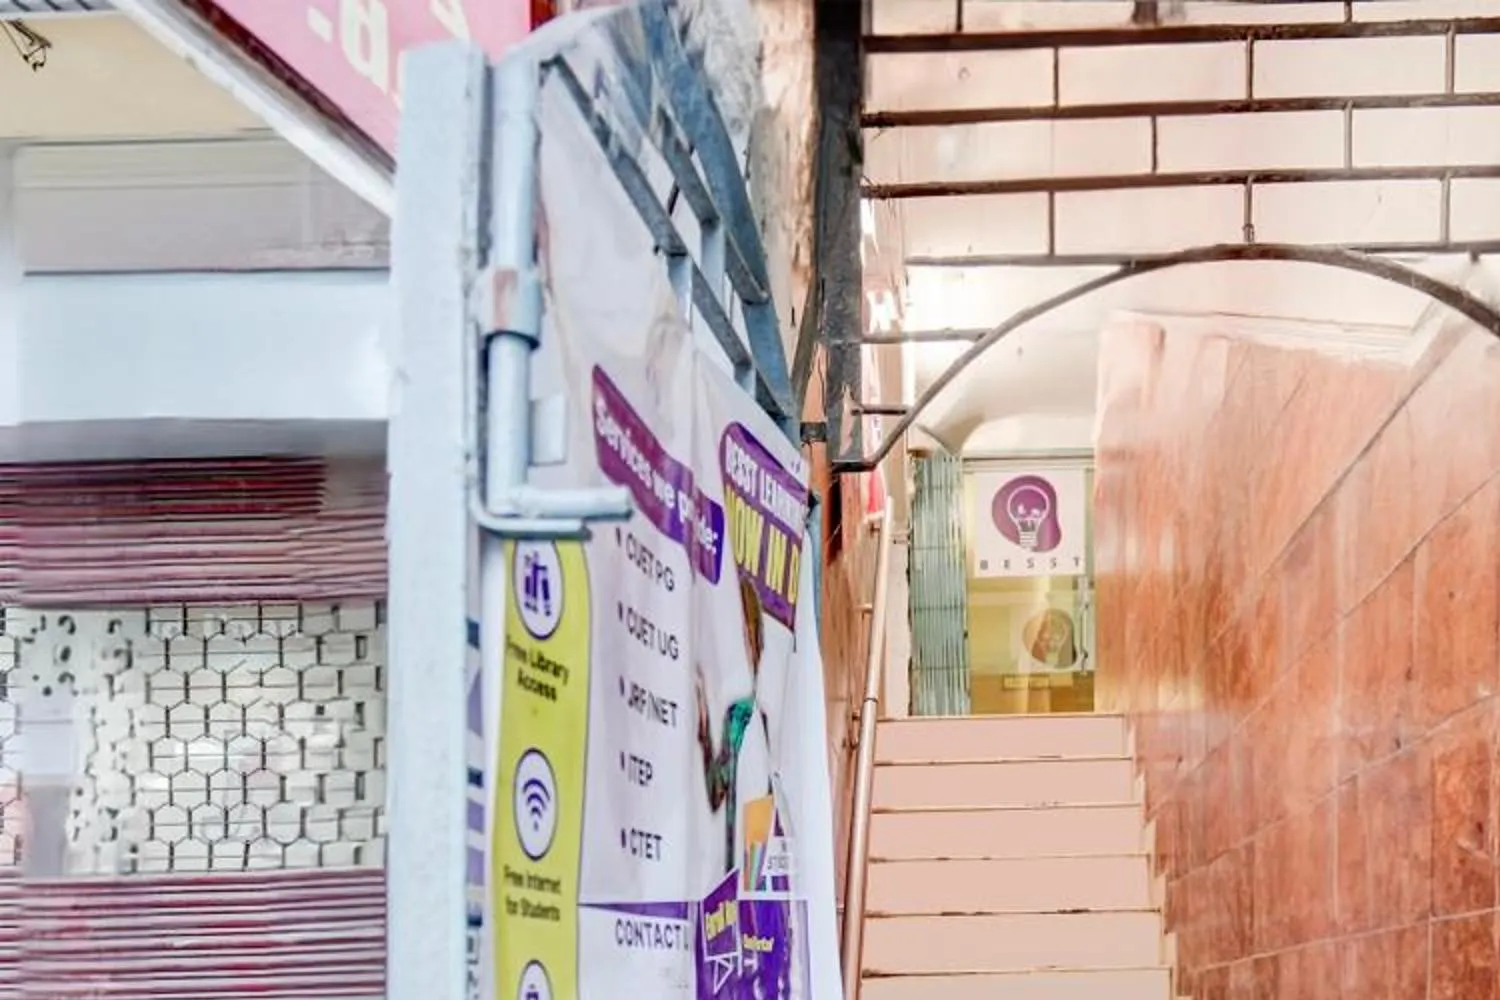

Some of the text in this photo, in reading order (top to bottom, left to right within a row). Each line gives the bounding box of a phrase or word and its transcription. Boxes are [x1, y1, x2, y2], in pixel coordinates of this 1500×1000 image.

[655, 559, 675, 592] PG
[657, 627, 679, 661] UG
[629, 827, 663, 862] CTET
[615, 917, 682, 951] CONTACT
